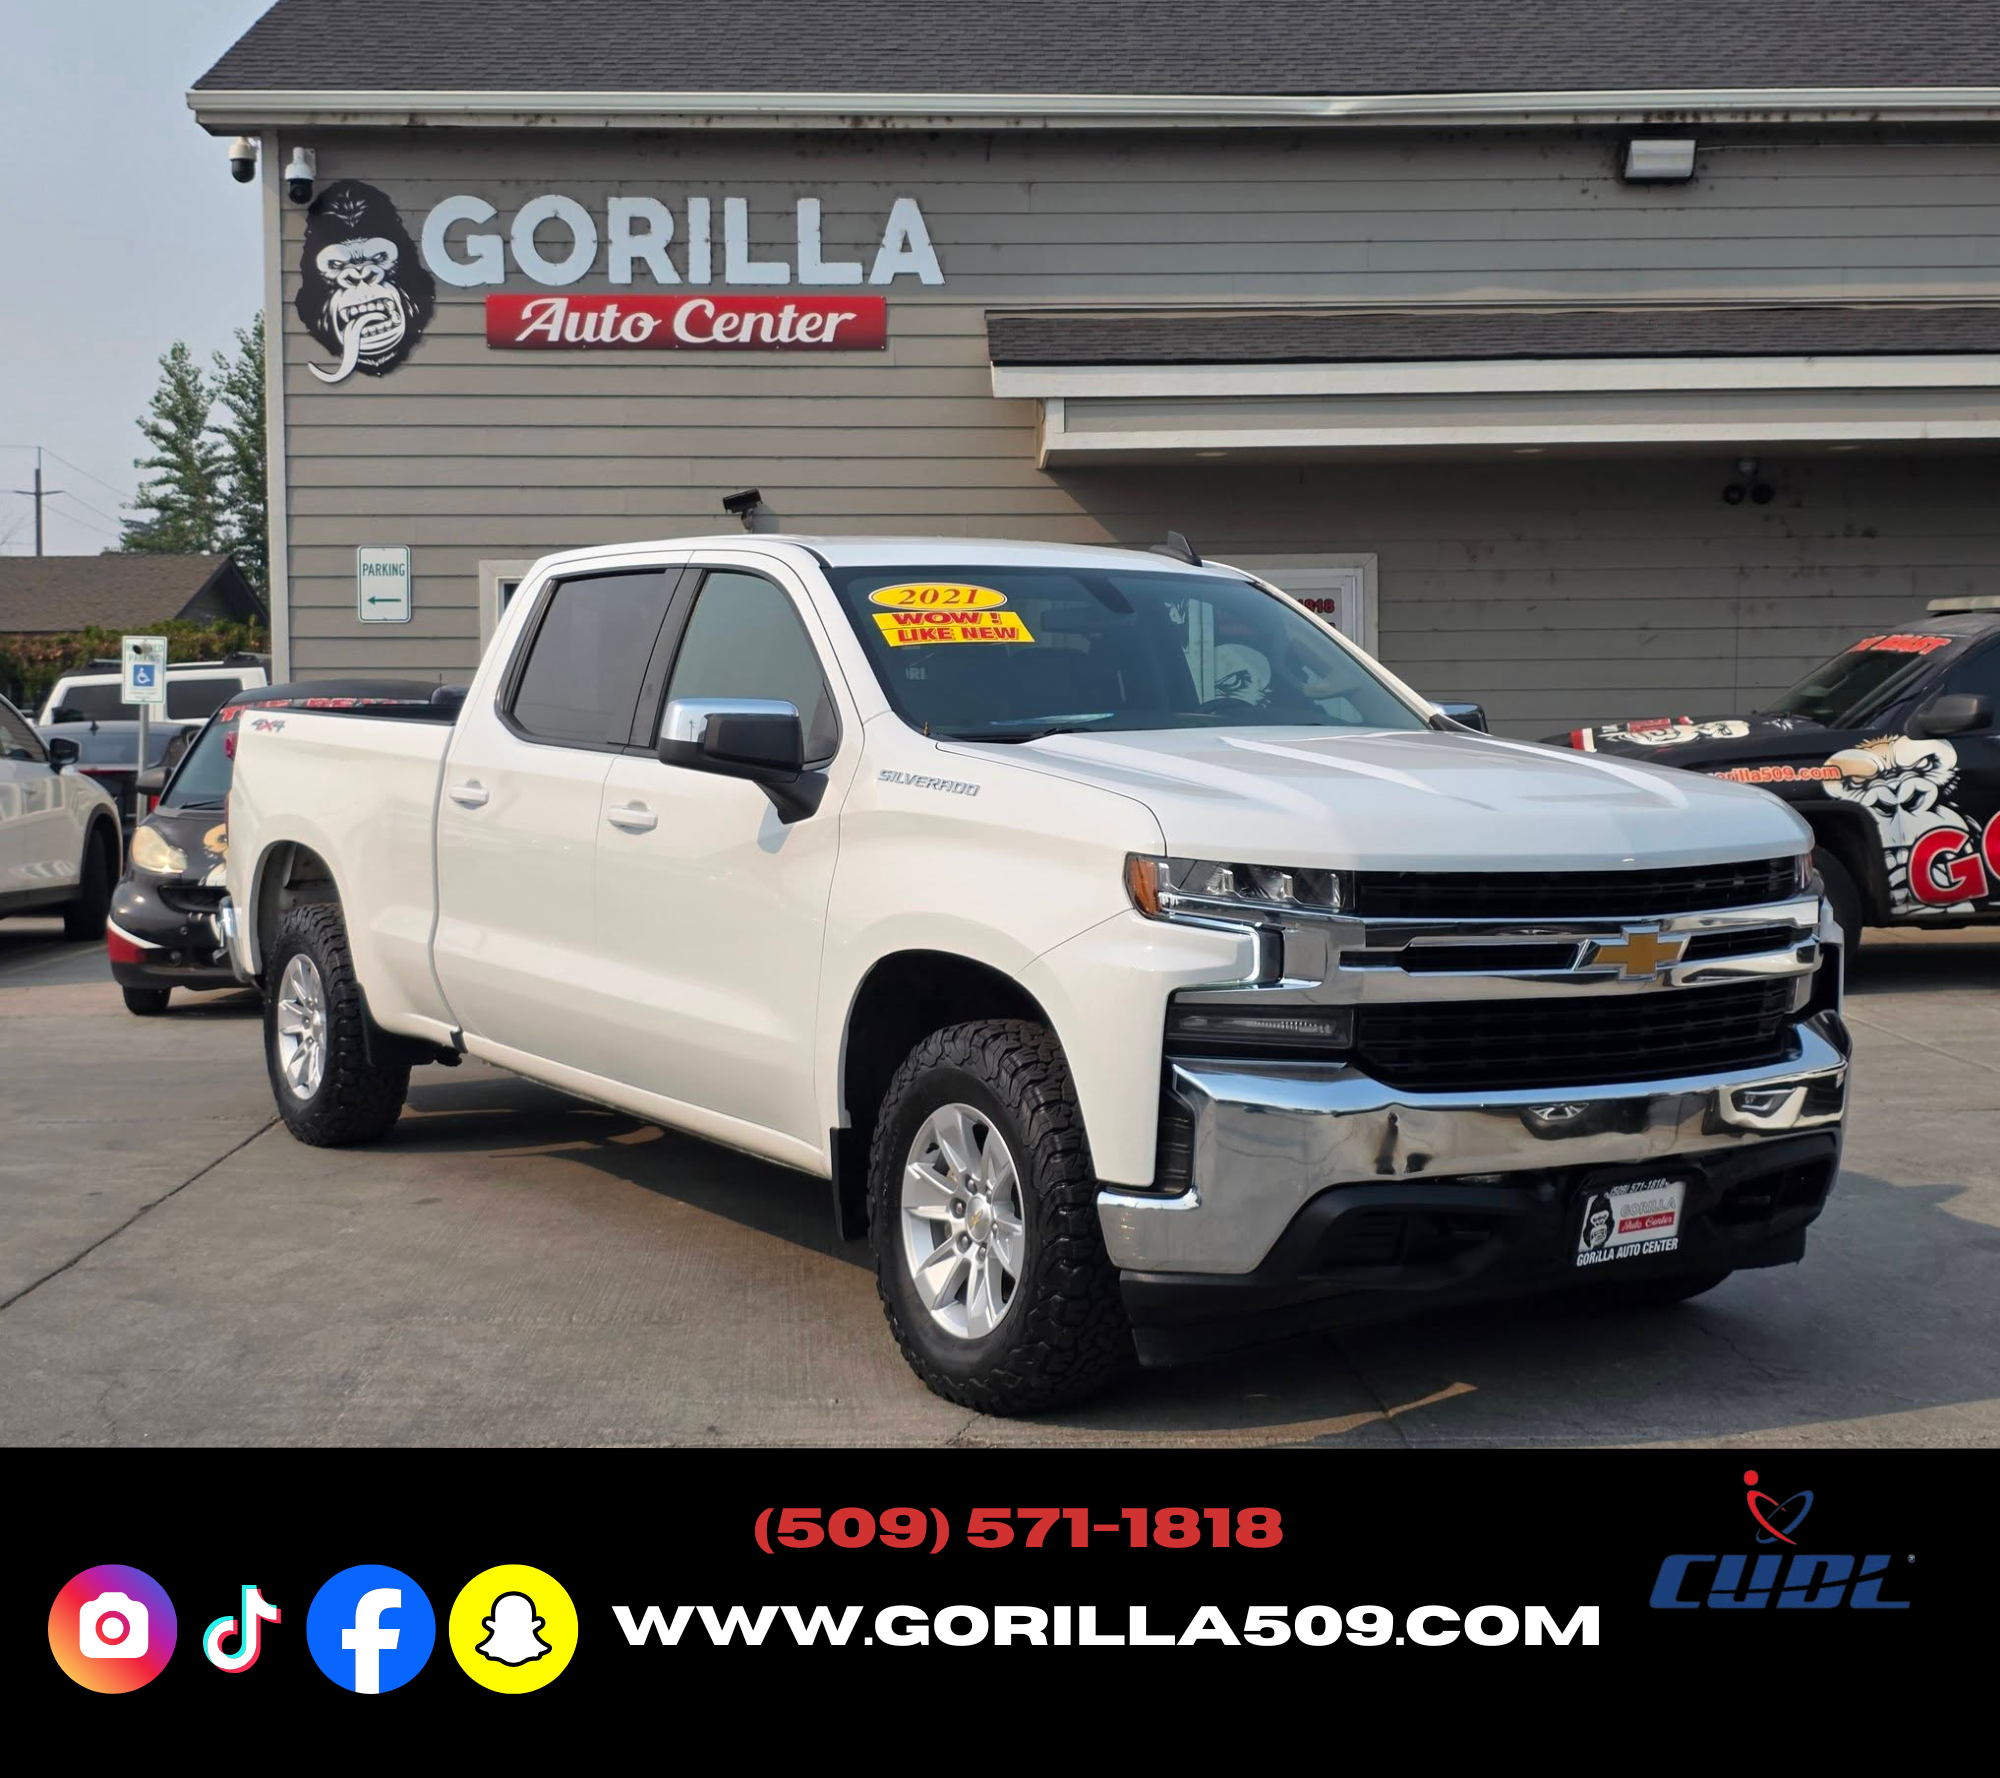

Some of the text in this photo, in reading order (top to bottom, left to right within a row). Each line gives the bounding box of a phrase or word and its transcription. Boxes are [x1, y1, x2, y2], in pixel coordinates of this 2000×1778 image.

[421, 194, 945, 287] GORILLA
[515, 297, 857, 344] Auto Center
[362, 563, 405, 577] PARKING
[898, 588, 979, 605] 2021
[1297, 598, 1335, 613] 818
[891, 612, 982, 626] WOW
[898, 627, 1019, 643] LIKE NEW
[878, 769, 981, 797] SILVERADO
[1709, 766, 1841, 784] orilla509.com
[1620, 1197, 1676, 1217] GORILLA
[1621, 1215, 1673, 1232] Auto Center
[1616, 1243, 1641, 1259] AUTO
[1642, 1238, 1678, 1254] CENTER
